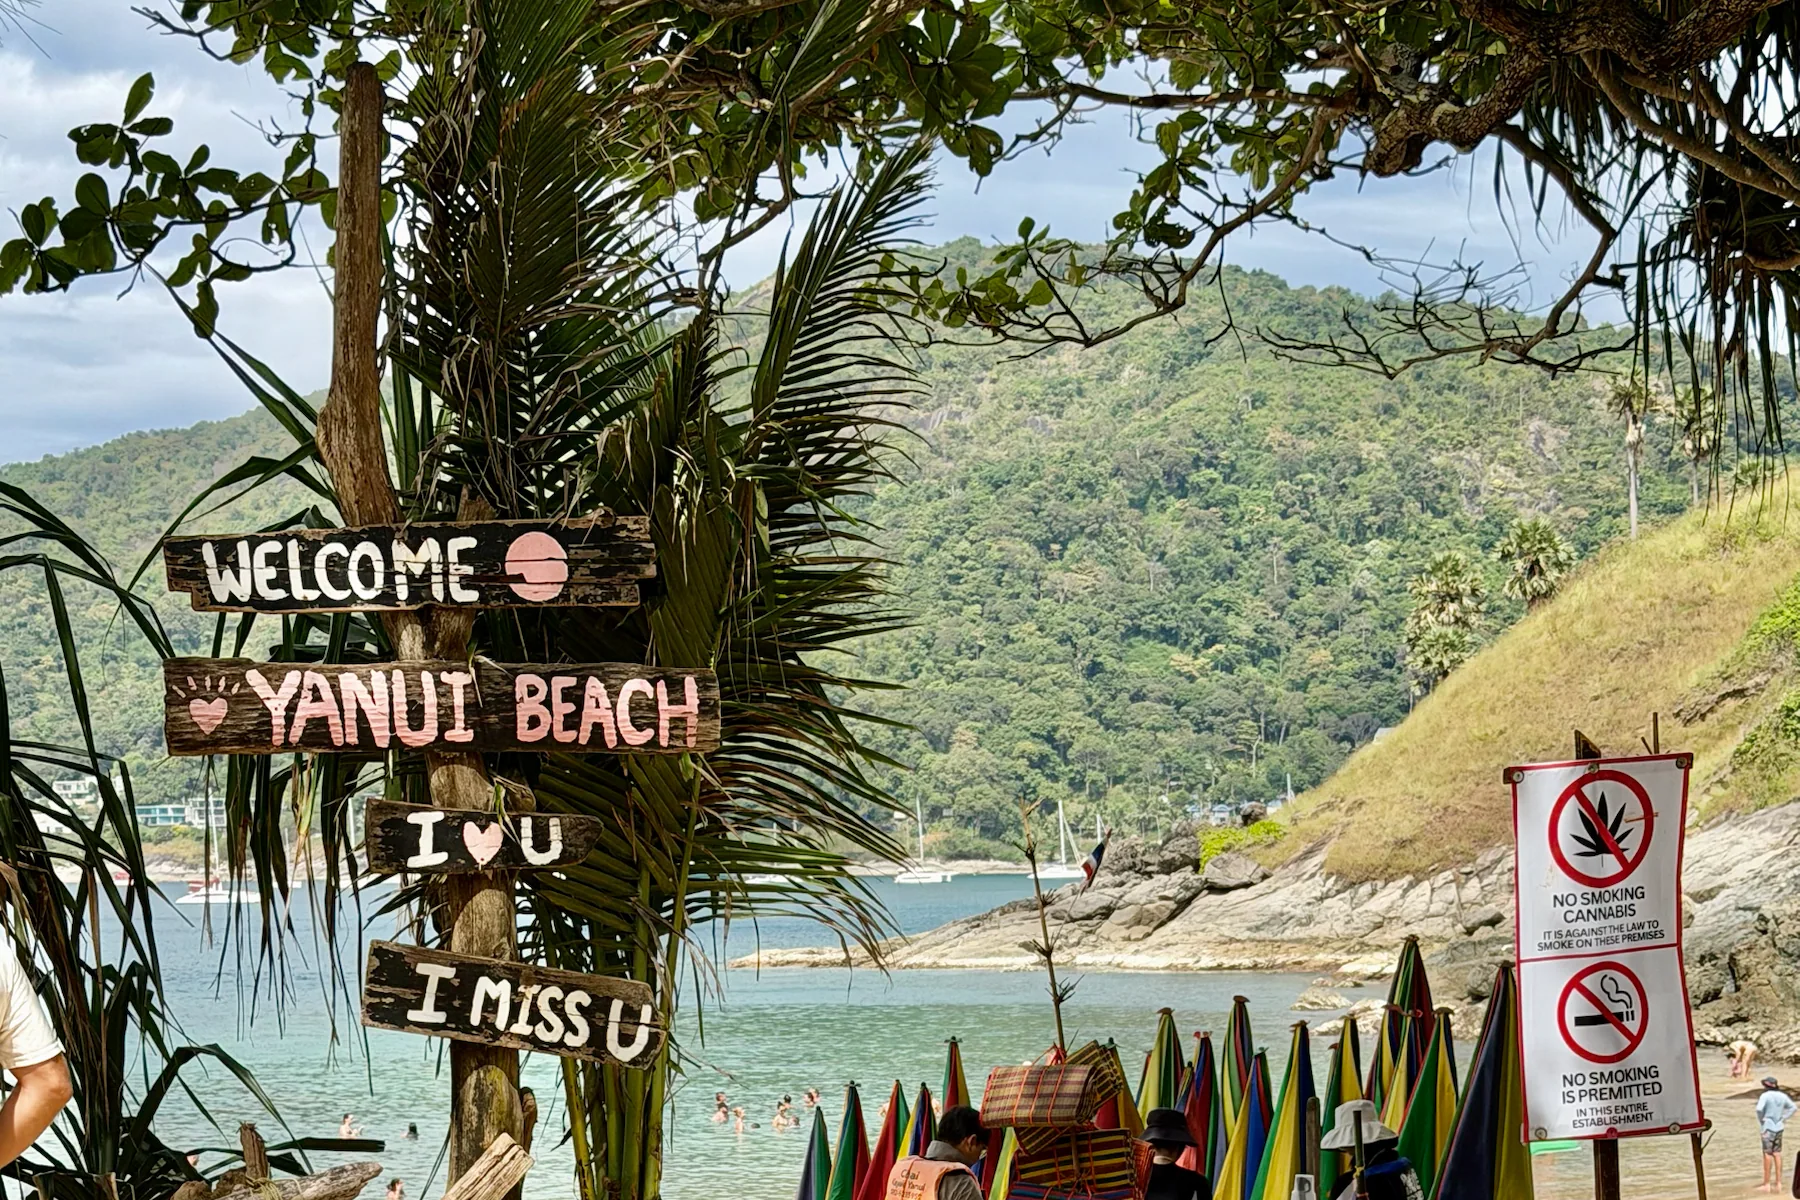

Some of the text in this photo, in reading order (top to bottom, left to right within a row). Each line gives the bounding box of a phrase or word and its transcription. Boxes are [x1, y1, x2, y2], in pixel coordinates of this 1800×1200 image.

[202, 535, 480, 604] WELCOME
[245, 668, 700, 749] YANUI BEACH
[406, 811, 564, 869] I U
[1552, 886, 1645, 908] NO SMOKING
[1563, 903, 1636, 924] CANNABIS
[1537, 929, 1665, 951] SMOKE ON THESE PREMISES
[1543, 920, 1659, 940] IT IS AGAINST THE LAW TO
[406, 962, 652, 1063] I MISS U
[1562, 1065, 1660, 1088] NO SMOKING
[1562, 1081, 1663, 1104] IS PREMITTED
[1572, 1112, 1654, 1129] ESTABLISHMENT
[1576, 1102, 1649, 1118] IN THIS ENTIRE
